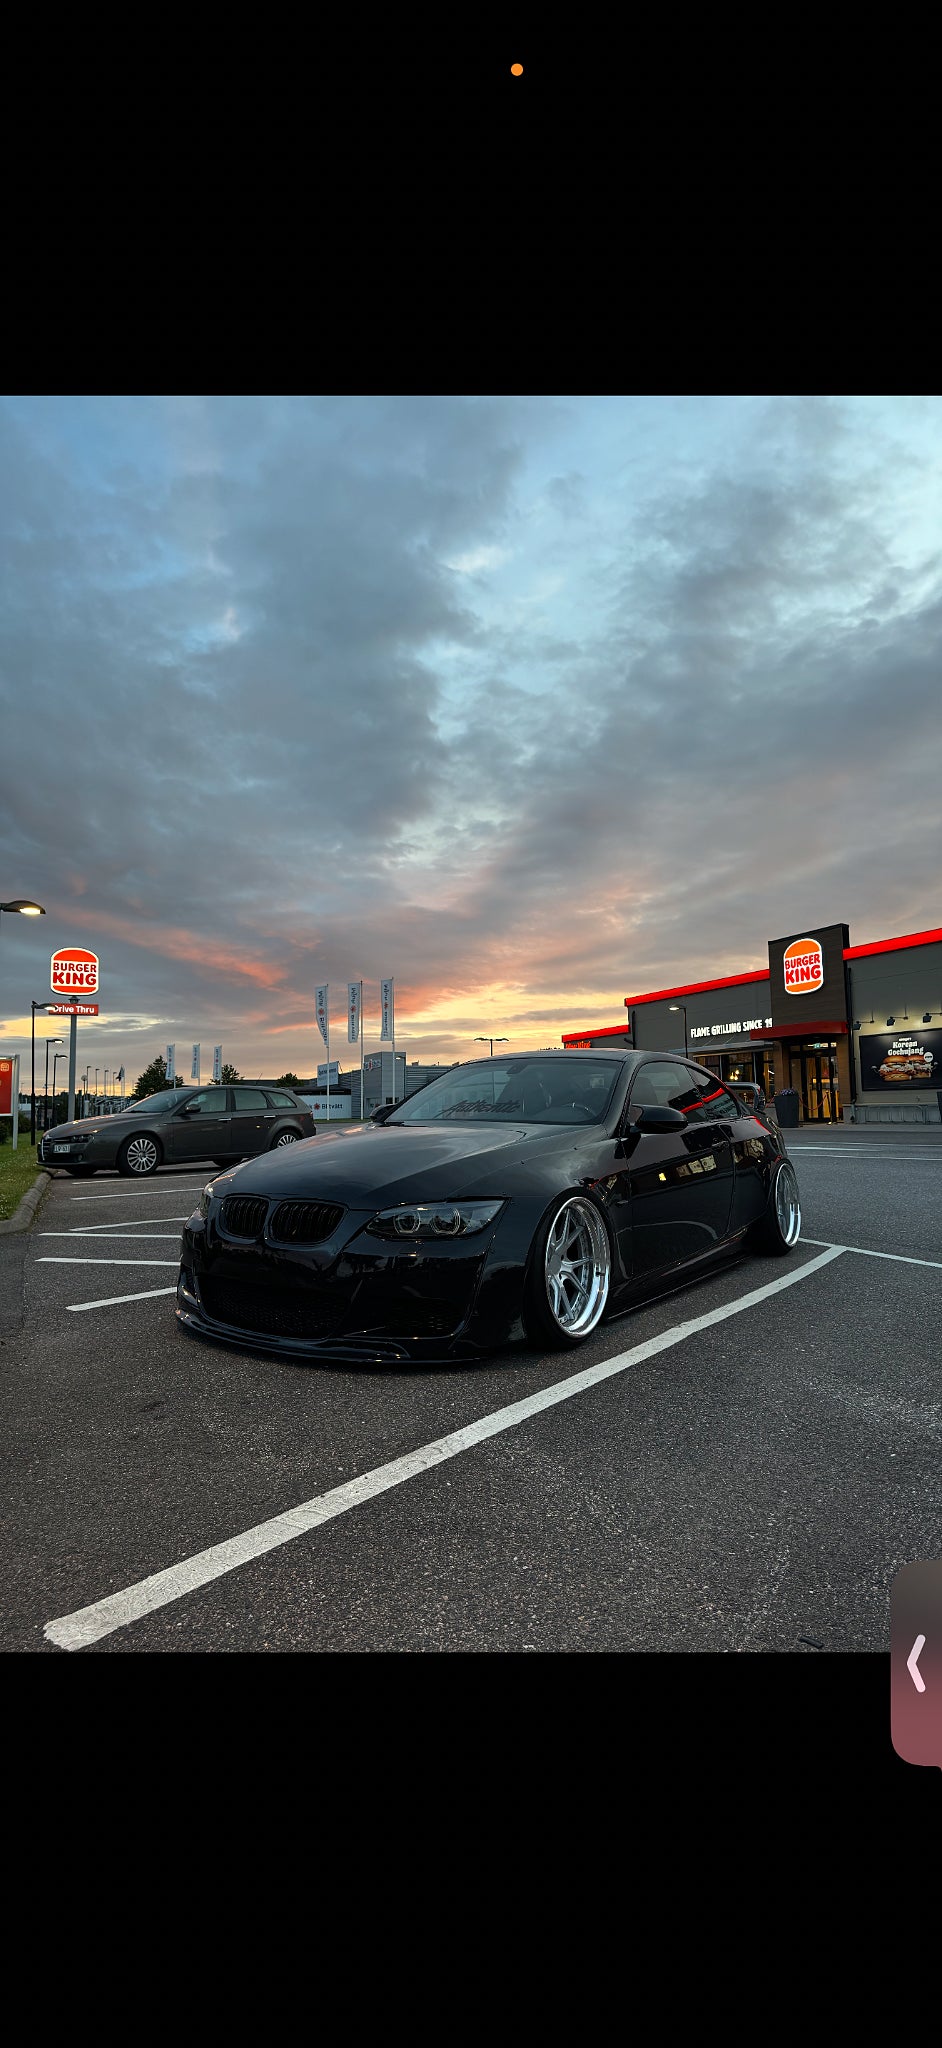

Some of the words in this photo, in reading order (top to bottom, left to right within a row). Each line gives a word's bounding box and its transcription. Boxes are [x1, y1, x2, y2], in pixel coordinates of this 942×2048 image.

[53, 962, 97, 973] BURGER
[785, 953, 821, 970] BURGER
[53, 972, 97, 985] KING
[785, 964, 821, 984] KING
[54, 1004, 74, 1013] Drive
[75, 1005, 95, 1014] Thru
[690, 1026, 711, 1038] FLAME
[711, 1021, 742, 1036] GRILLING
[742, 1019, 762, 1031] SINCE
[887, 1046, 925, 1056] Gochujang
[892, 1041, 918, 1049] Korean
